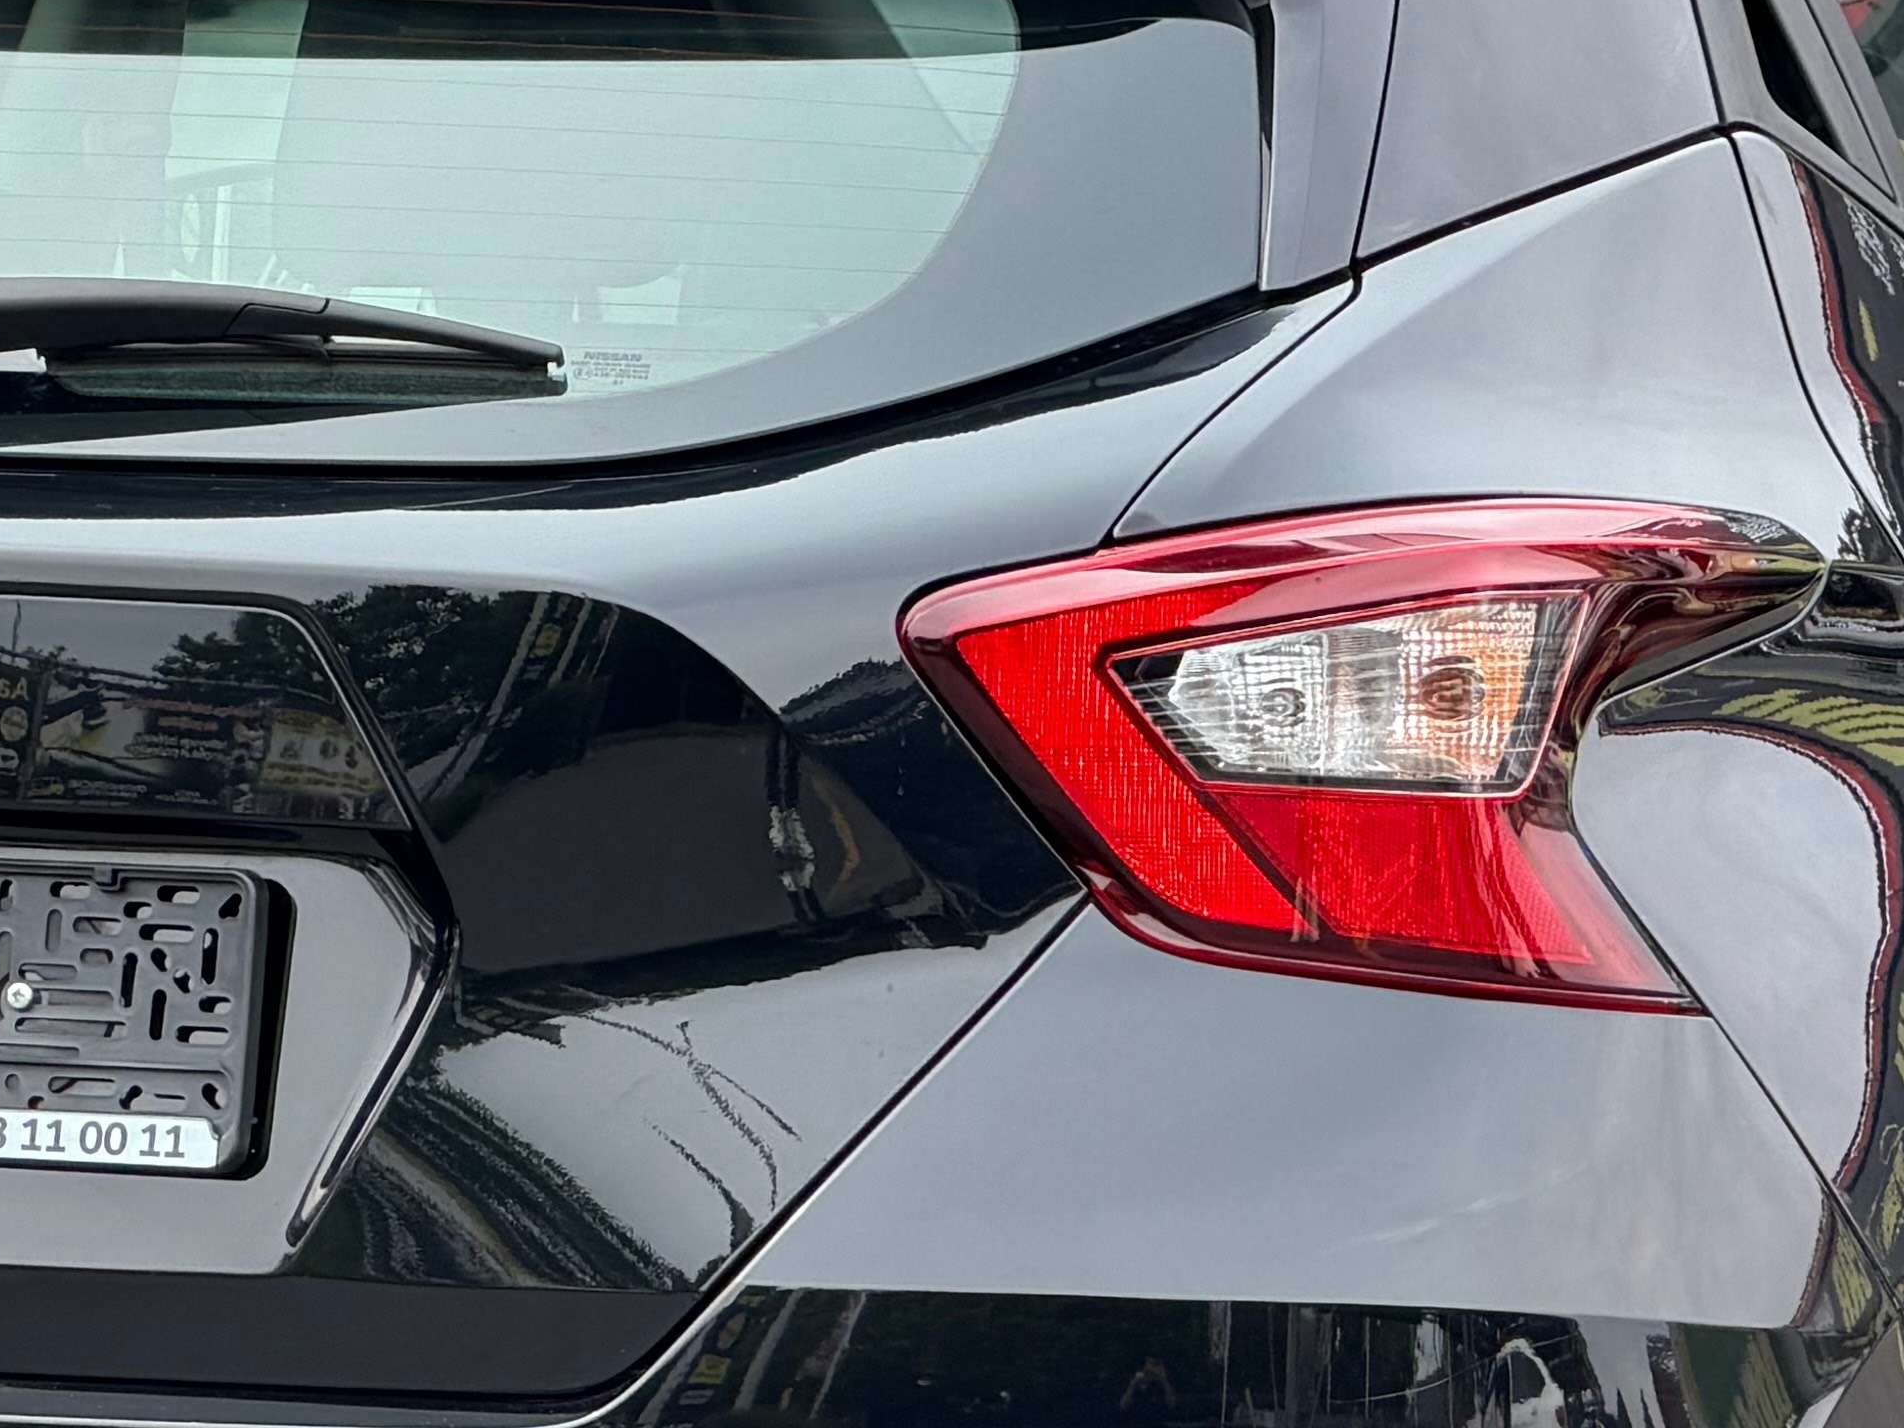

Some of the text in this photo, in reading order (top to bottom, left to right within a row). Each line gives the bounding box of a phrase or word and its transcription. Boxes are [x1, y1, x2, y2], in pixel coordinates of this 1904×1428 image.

[21, 1118, 66, 1153] 11
[79, 1120, 129, 1156] 00
[139, 1124, 186, 1159] 11
